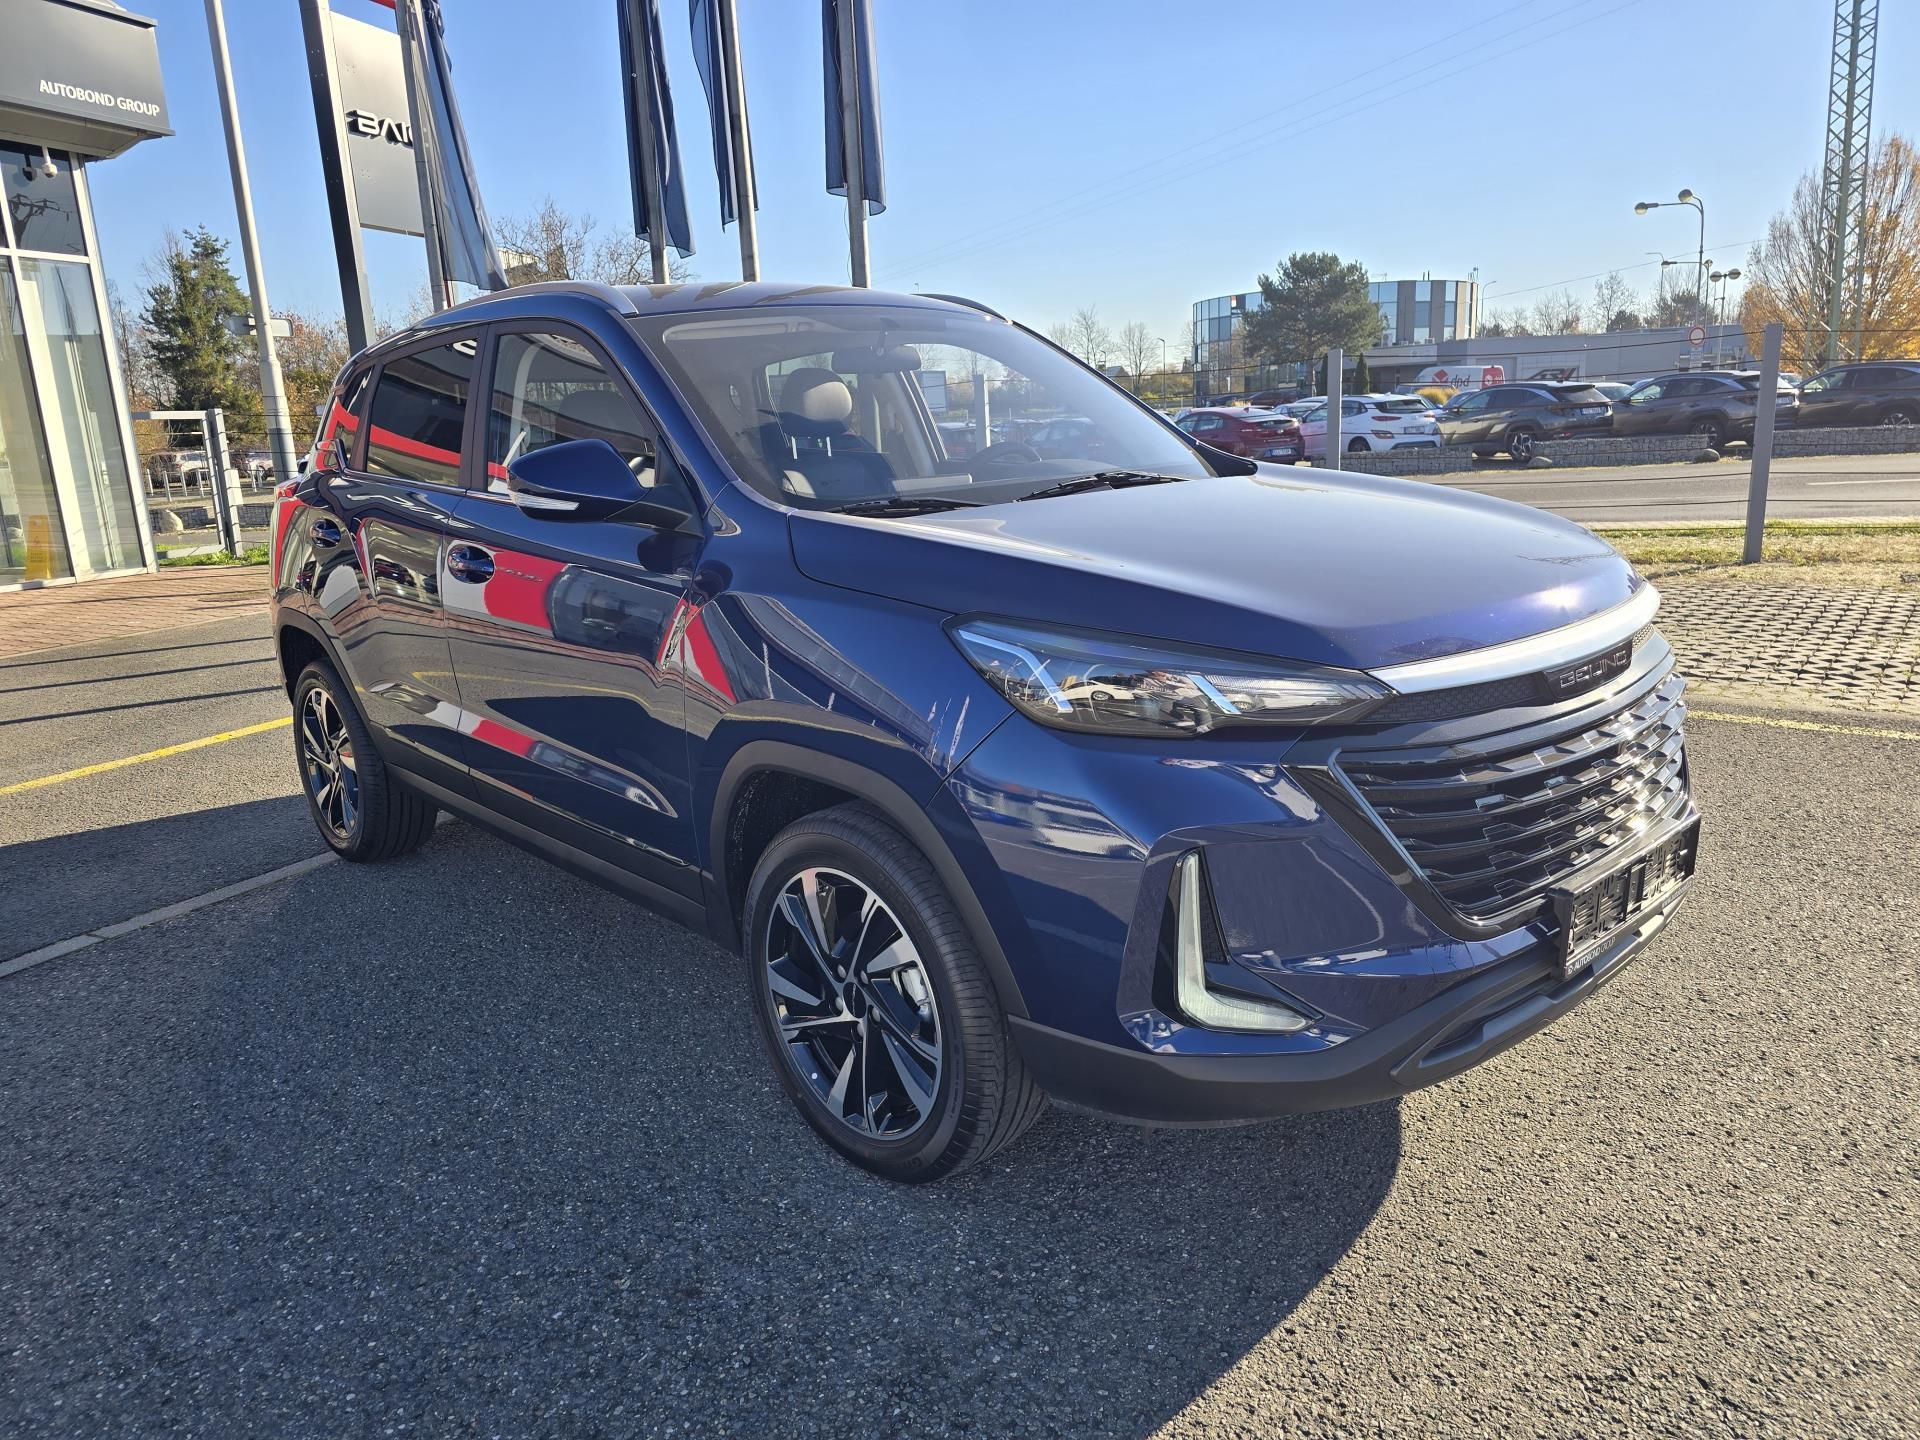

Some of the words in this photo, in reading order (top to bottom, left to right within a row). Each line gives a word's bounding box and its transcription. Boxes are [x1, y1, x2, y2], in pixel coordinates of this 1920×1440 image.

[39, 79, 115, 107] AUTOBOND
[117, 97, 160, 117] GROUP
[349, 109, 413, 144] BAI
[1560, 650, 1627, 688] BEIJING
[1574, 947, 1600, 971] AUTOBOND
[1601, 937, 1616, 953] GROUP
